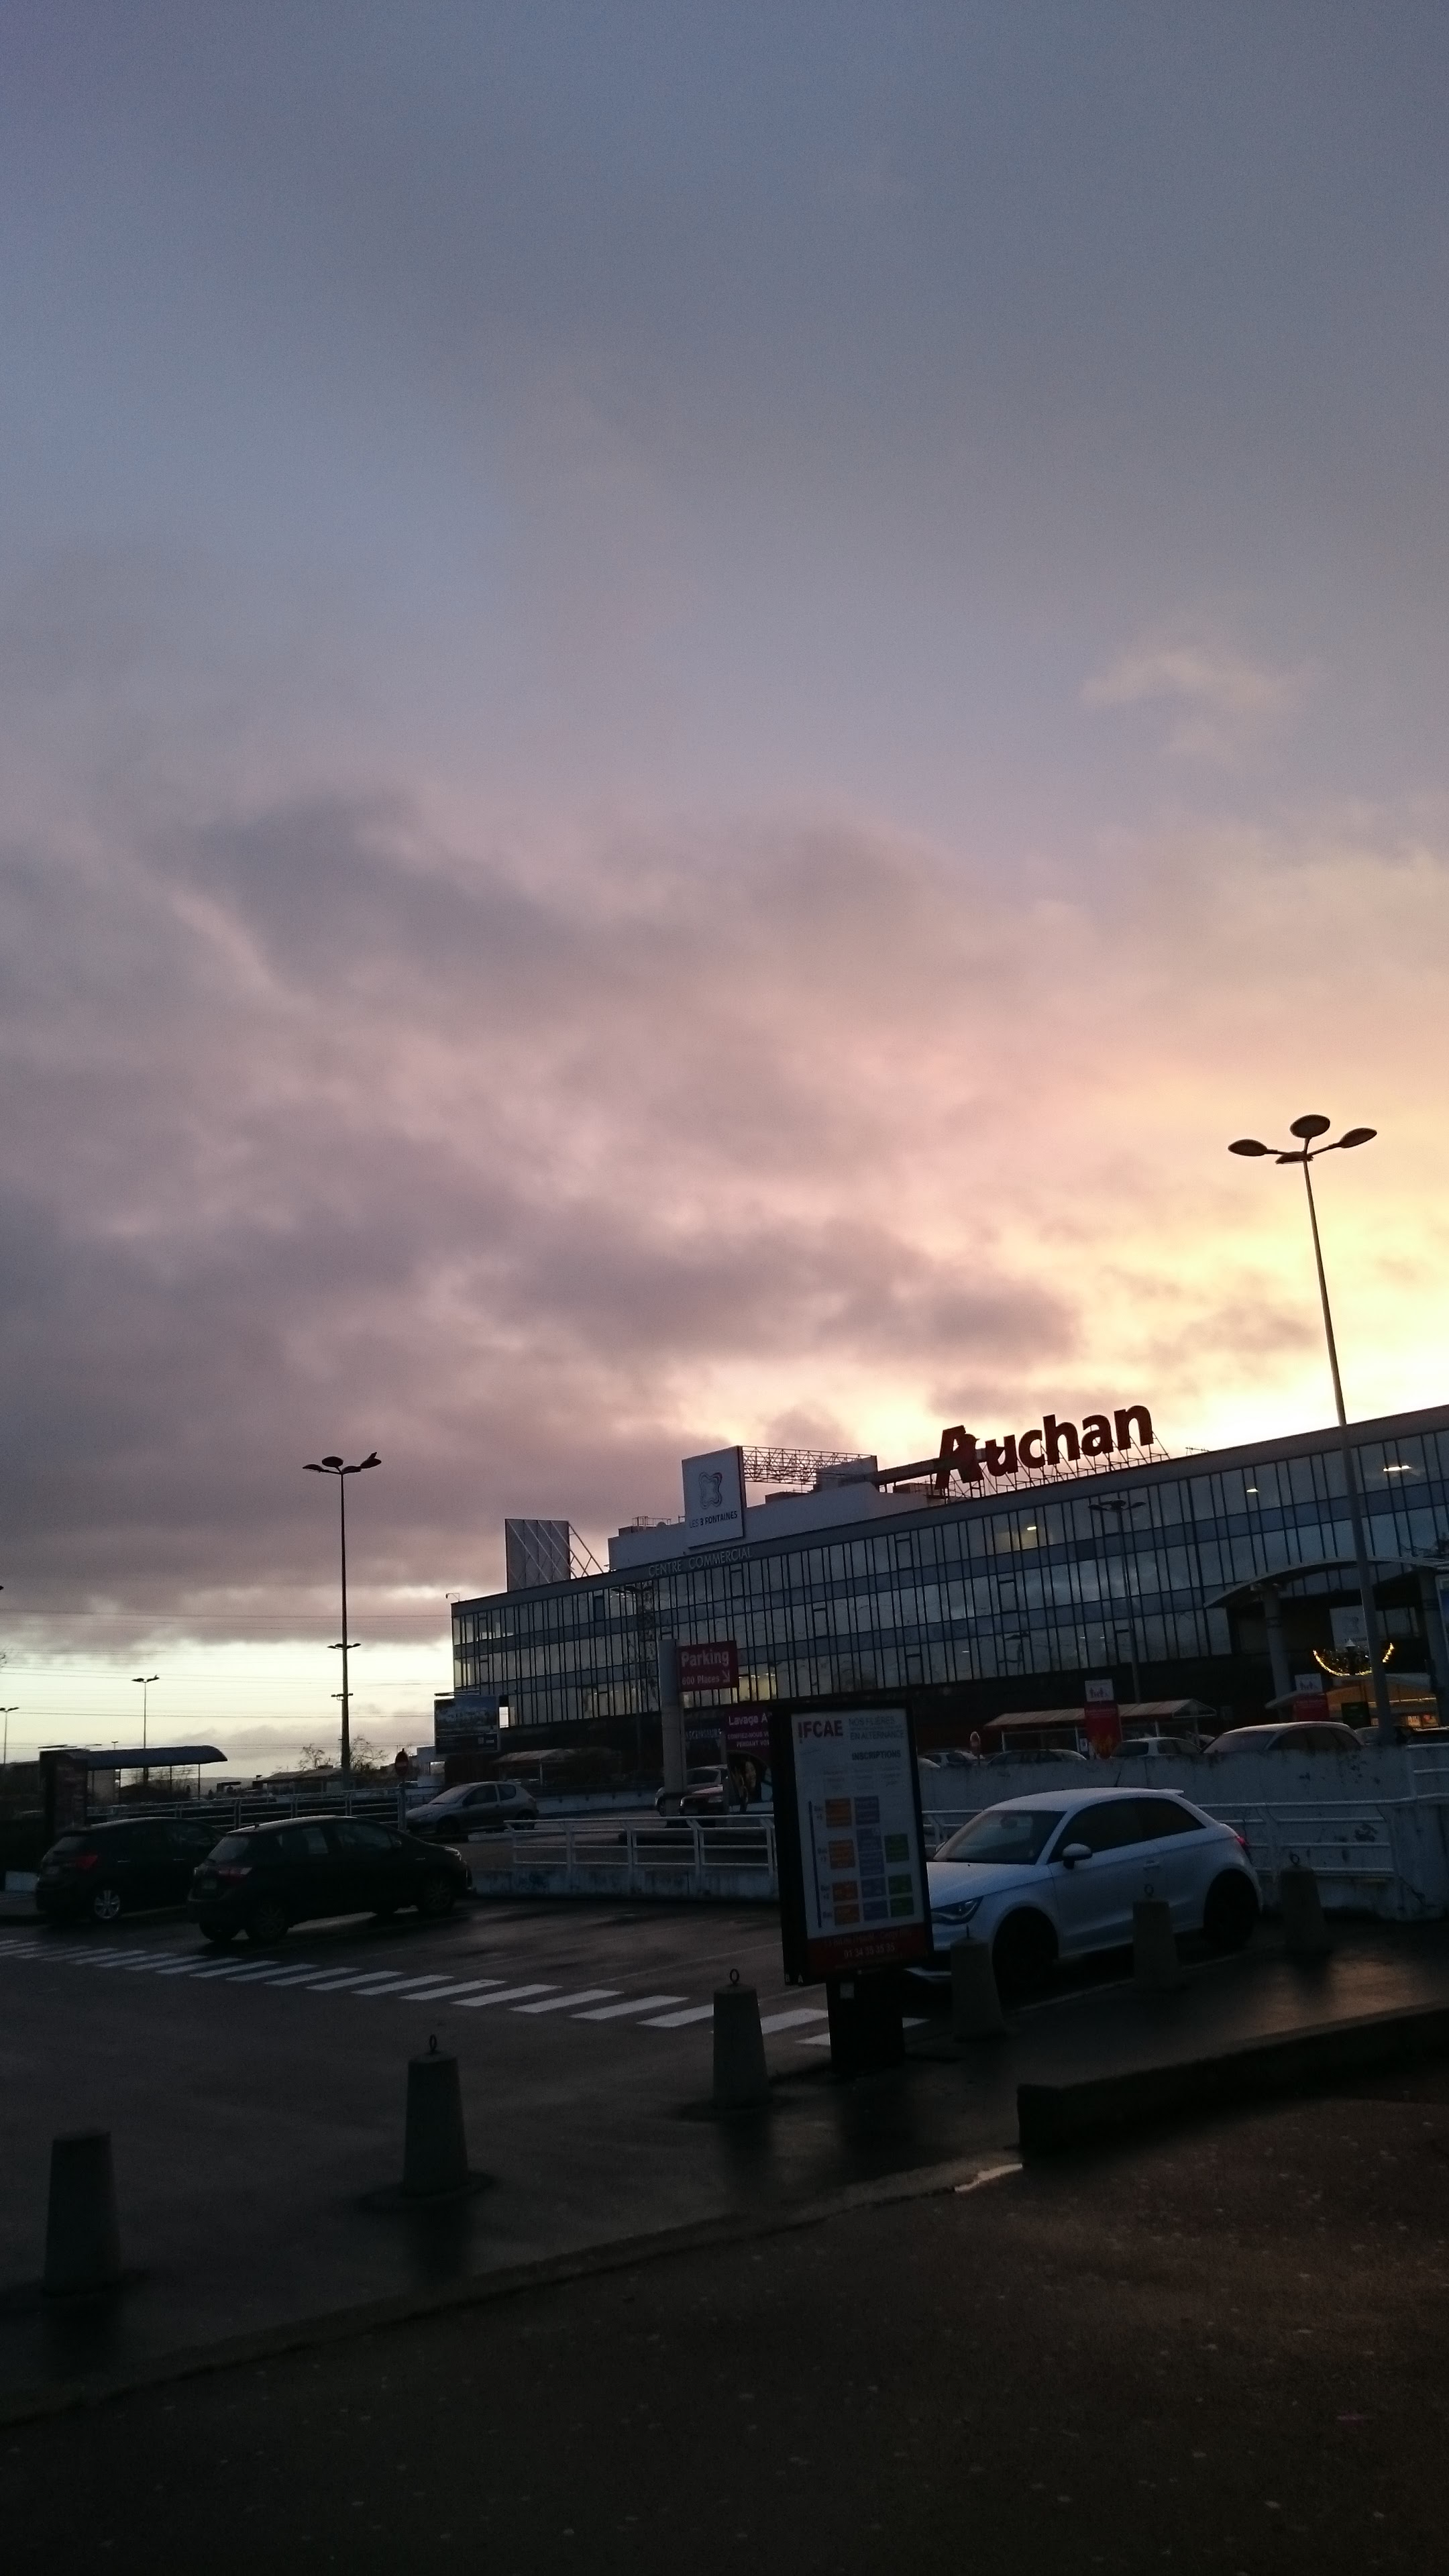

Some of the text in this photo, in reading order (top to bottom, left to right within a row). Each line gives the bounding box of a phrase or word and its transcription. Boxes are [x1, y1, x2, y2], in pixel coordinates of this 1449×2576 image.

[935, 1405, 1154, 1490] Auchan
[689, 1510, 738, 1529] LES 3 FONTAINES
[648, 1546, 753, 1577] CENTRE COMMERCIAL
[681, 1648, 730, 1668] Parking
[682, 1674, 720, 1685] 600 Places
[729, 1715, 759, 1726] Lavage
[798, 1720, 843, 1739] IFCAE
[850, 1732, 860, 1740] EN
[852, 1750, 902, 1761] INSCRIPTIONS
[843, 1949, 853, 1960] 01
[854, 1947, 863, 1957] 34
[875, 1943, 885, 1953] 35
[885, 1942, 896, 1953] 35
